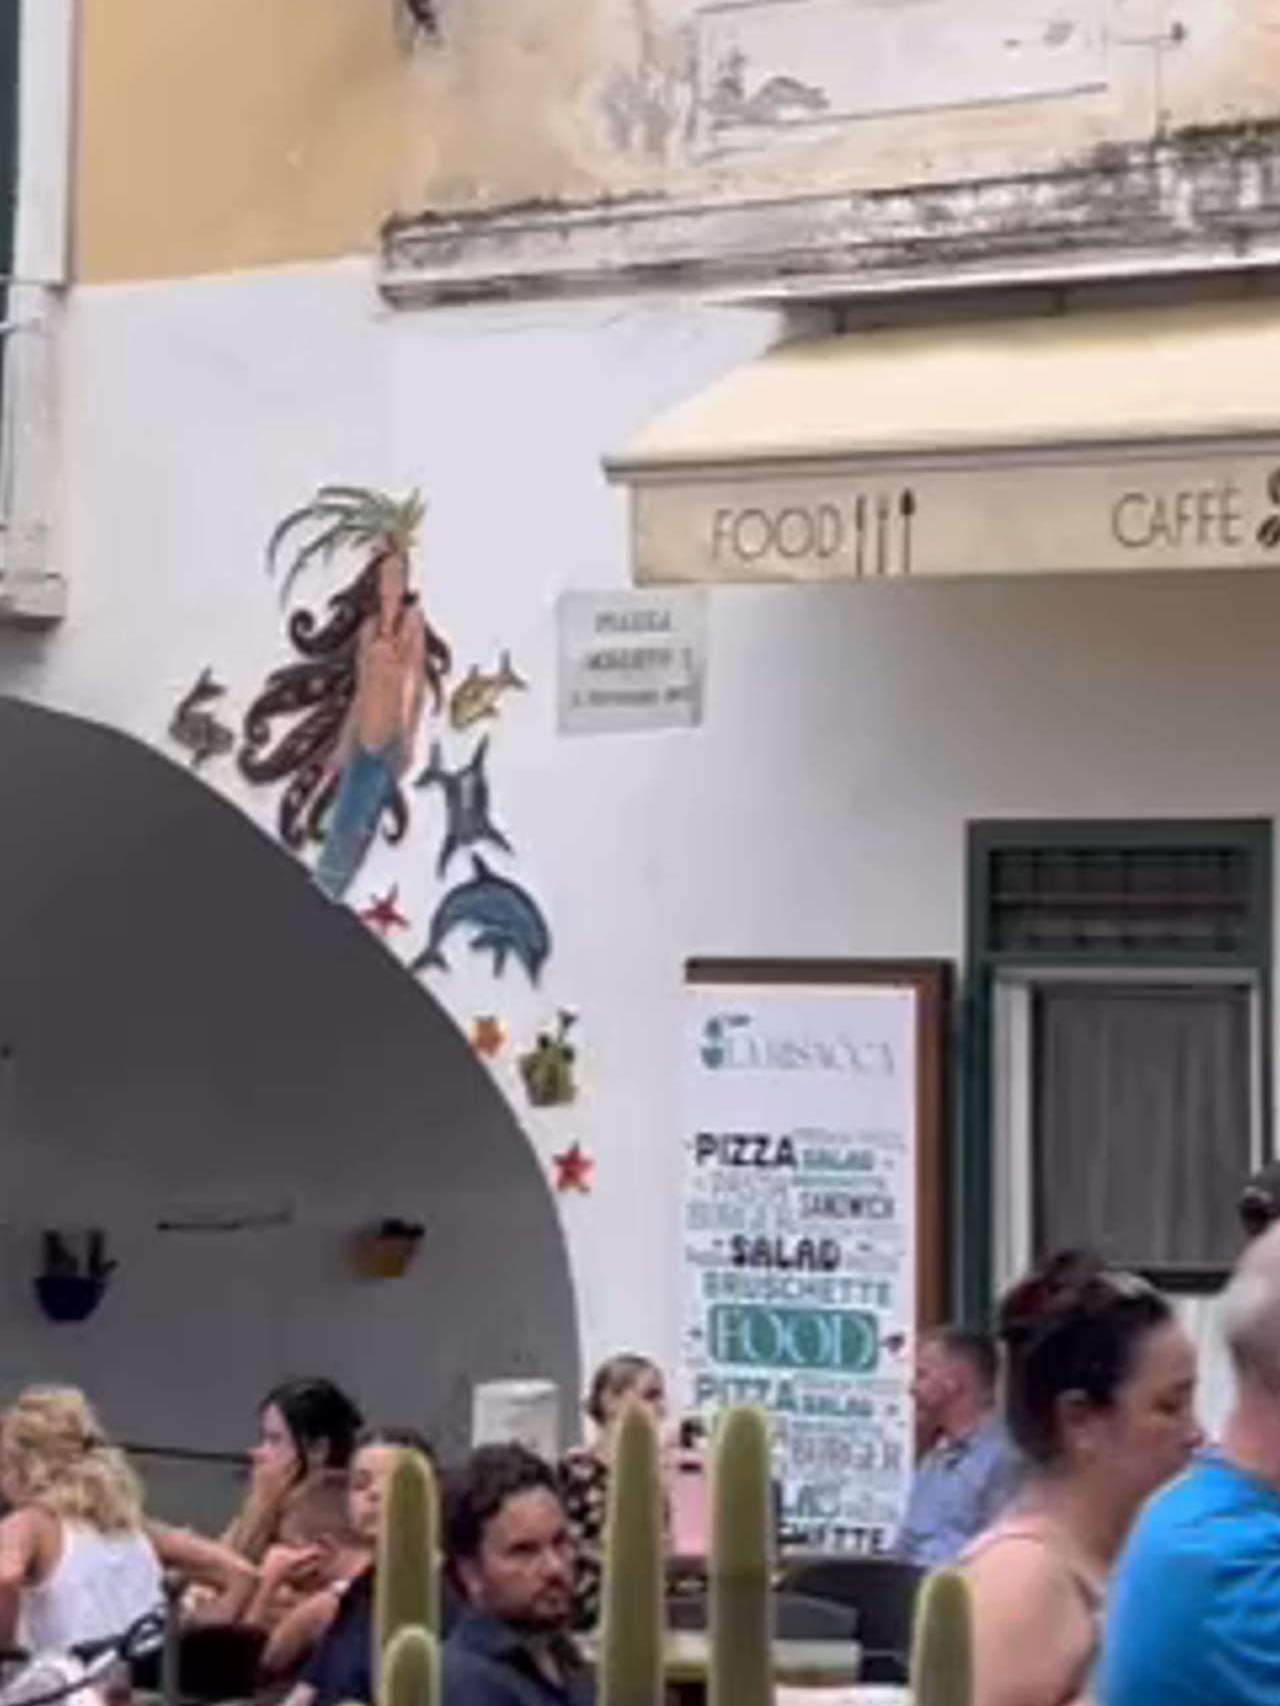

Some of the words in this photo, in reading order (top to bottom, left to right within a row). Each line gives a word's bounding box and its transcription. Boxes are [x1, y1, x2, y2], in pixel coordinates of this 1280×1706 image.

[712, 502, 842, 562] FOOD
[696, 1132, 798, 1167] PIZZA
[730, 1234, 842, 1272] SALAD
[717, 1310, 873, 1369] FOOD
